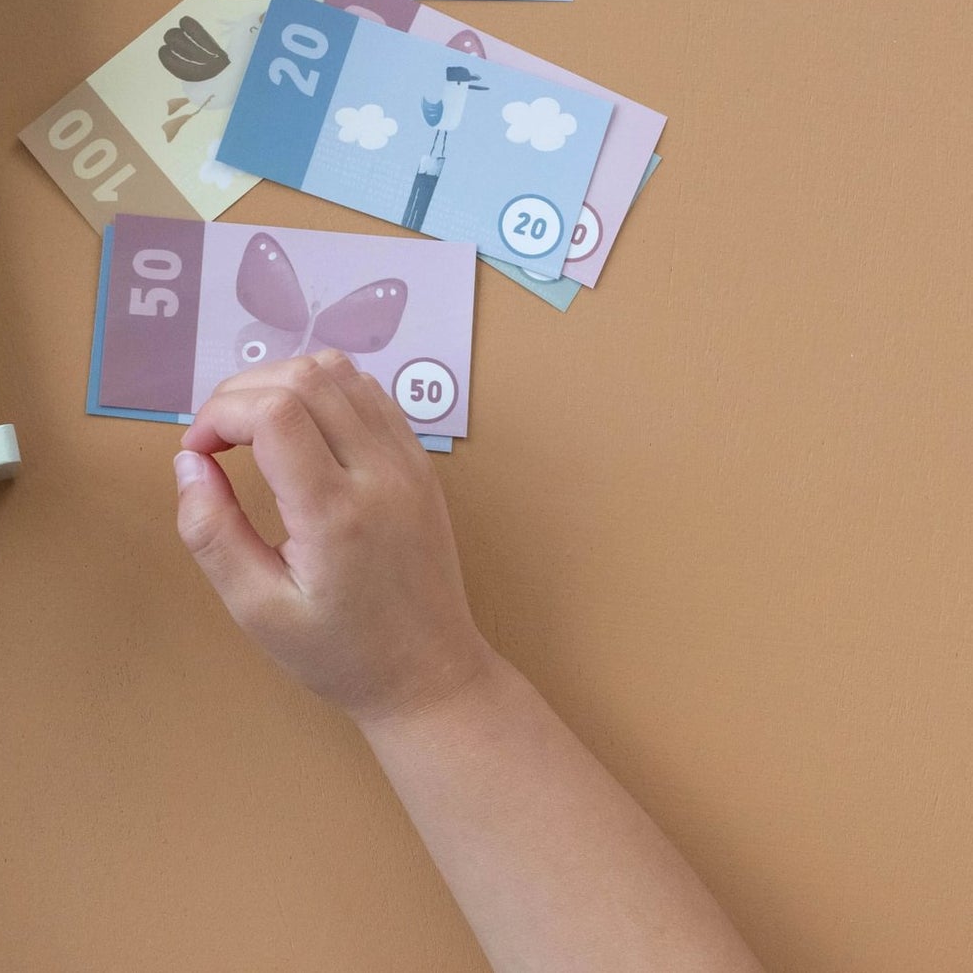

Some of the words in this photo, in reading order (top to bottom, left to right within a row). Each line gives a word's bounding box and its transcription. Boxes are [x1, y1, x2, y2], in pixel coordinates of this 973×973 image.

[268, 23, 329, 98] 20
[47, 108, 137, 203] 100
[513, 211, 547, 240] 20
[570, 223, 588, 246] 0
[128, 248, 183, 318] 50
[409, 378, 443, 404] 50
